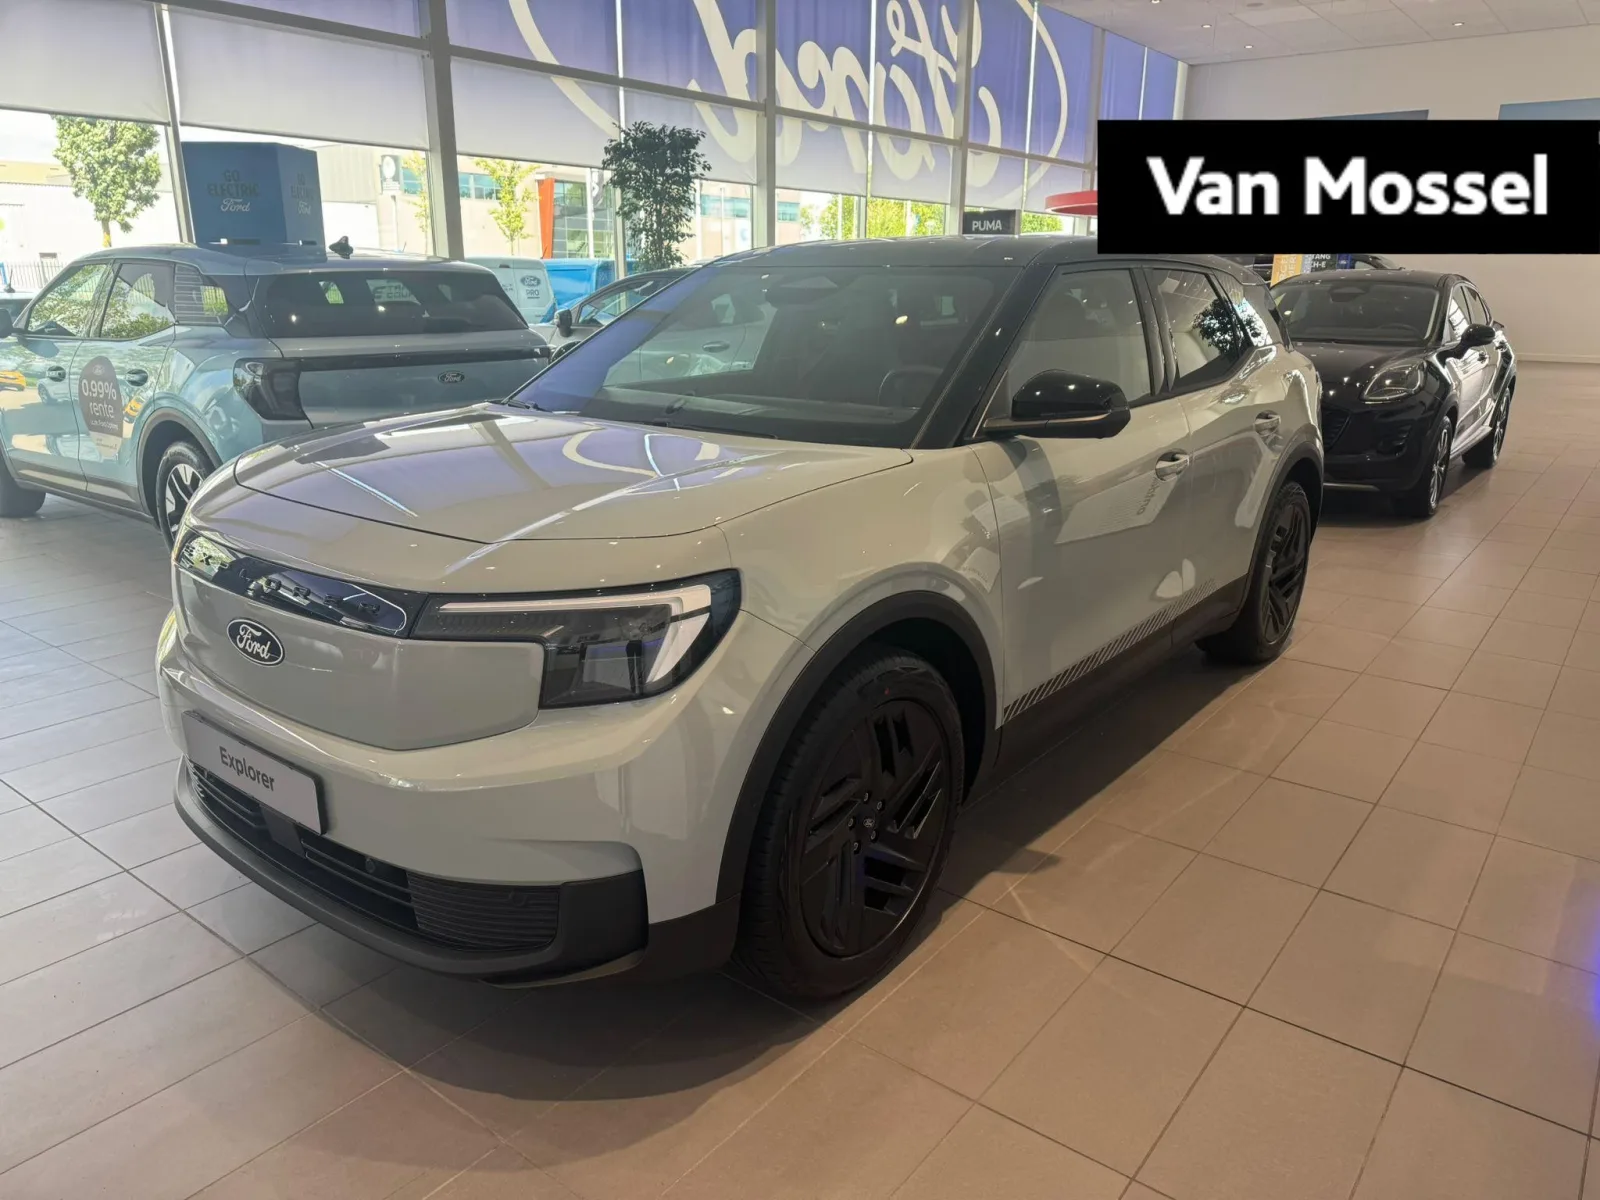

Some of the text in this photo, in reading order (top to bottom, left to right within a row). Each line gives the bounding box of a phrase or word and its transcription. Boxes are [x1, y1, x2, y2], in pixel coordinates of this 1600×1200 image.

[223, 170, 240, 182] GO
[207, 182, 260, 197] ELECTRIC
[220, 198, 251, 212] Ford
[972, 220, 1002, 231] PUMA
[526, 289, 540, 297] PRO
[82, 379, 117, 400] 0.99%
[90, 401, 114, 418] rente
[236, 623, 272, 660] Ford
[219, 745, 275, 792] Explorer
